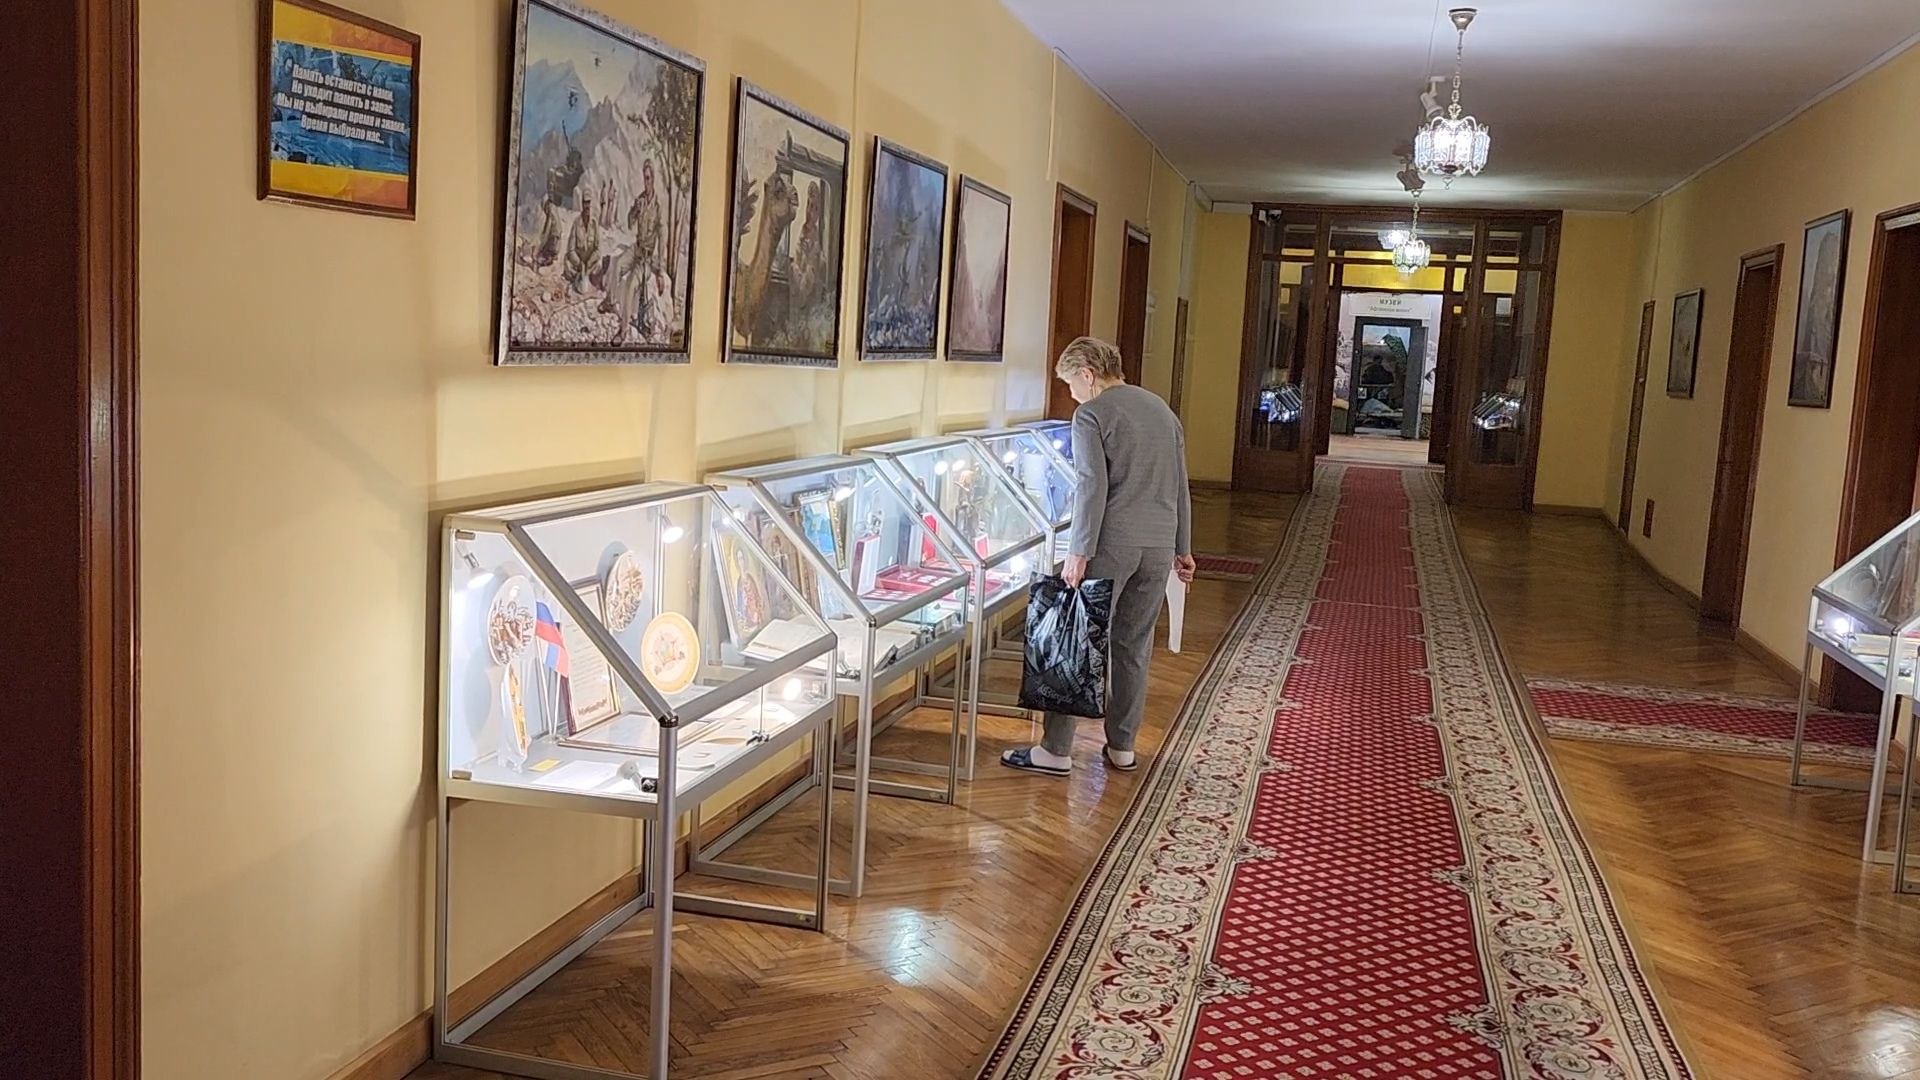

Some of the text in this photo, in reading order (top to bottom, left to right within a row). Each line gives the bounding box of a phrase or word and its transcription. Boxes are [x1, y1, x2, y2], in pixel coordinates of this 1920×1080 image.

[292, 80, 303, 94] Не
[303, 84, 333, 102] уходит
[332, 92, 364, 109] память
[364, 99, 370, 111] в
[293, 64, 324, 84] Память
[324, 74, 367, 95] останется
[366, 84, 373, 96] с
[276, 92, 293, 108] Мы
[293, 98, 305, 111] не
[304, 100, 349, 121] выбирали
[348, 111, 375, 128] время
[374, 117, 381, 129] и
[301, 114, 329, 133] Время
[328, 122, 366, 141] выбрало
